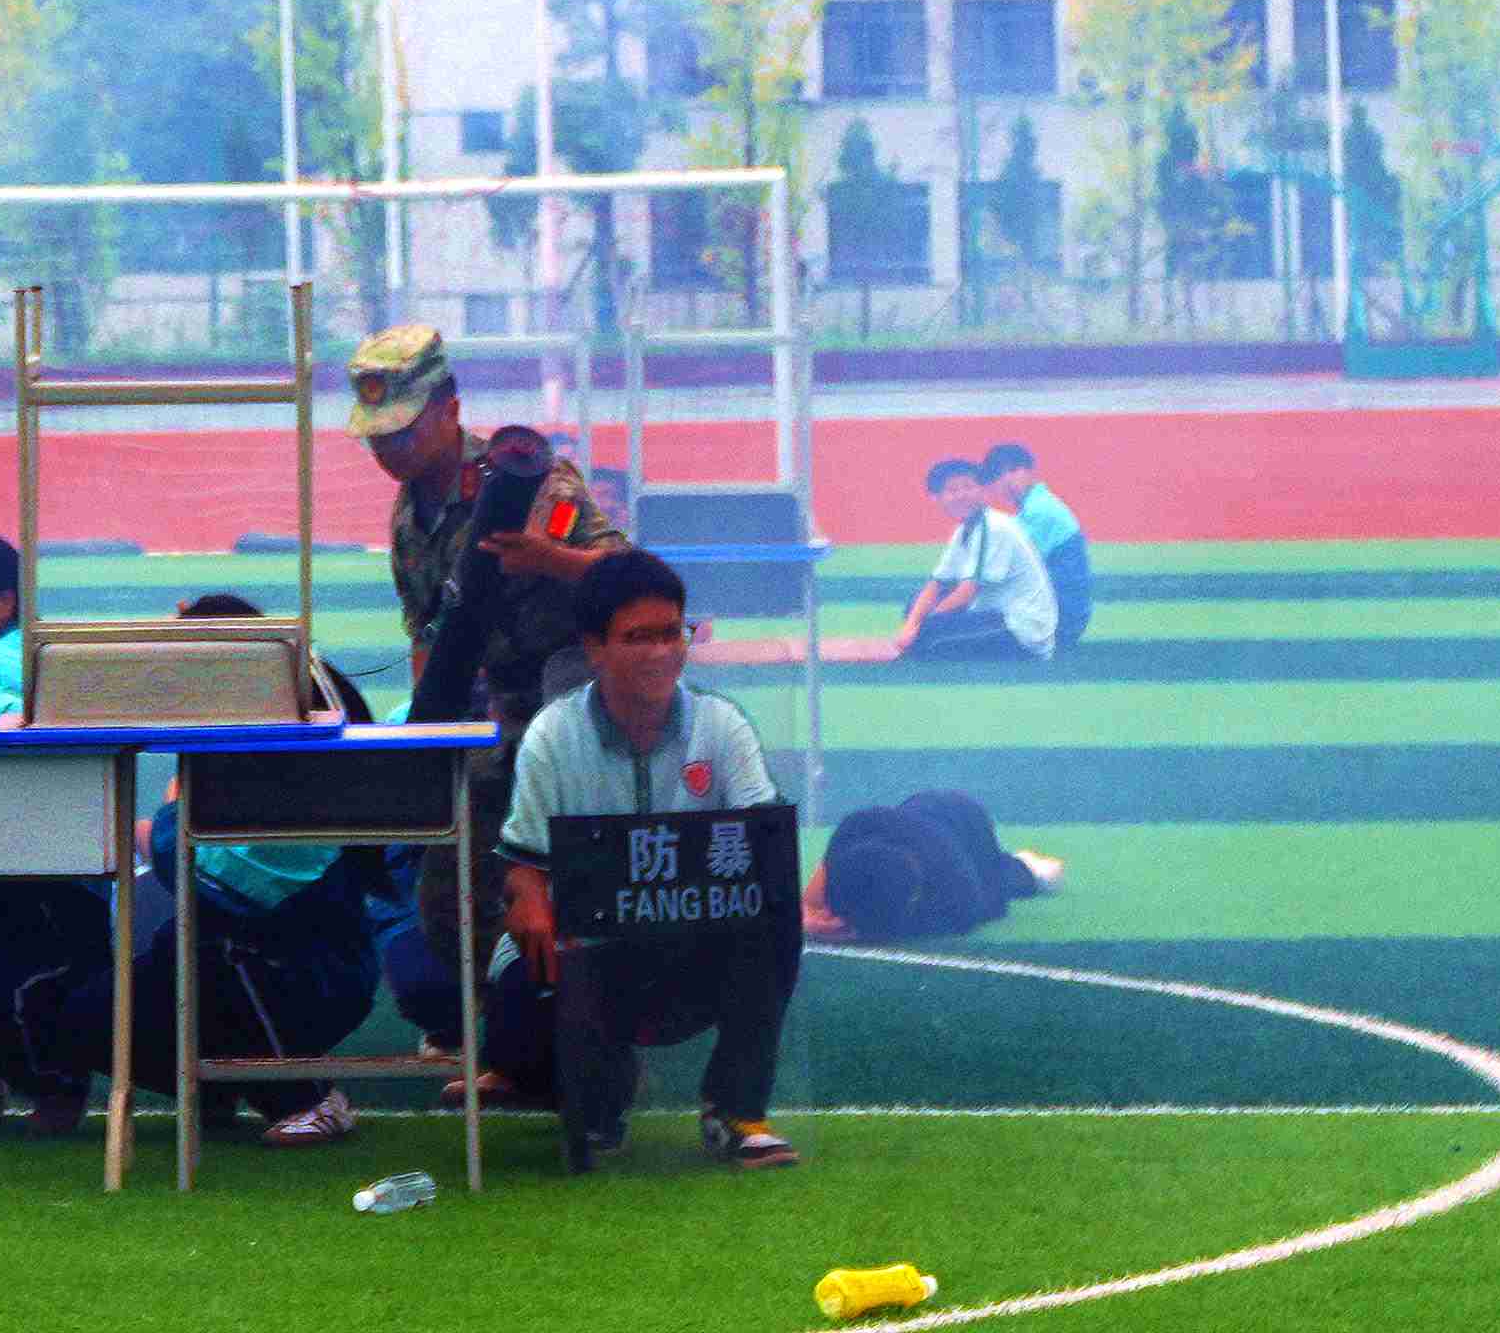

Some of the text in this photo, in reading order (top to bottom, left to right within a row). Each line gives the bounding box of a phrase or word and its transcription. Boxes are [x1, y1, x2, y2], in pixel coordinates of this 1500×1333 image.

[629, 821, 752, 883] 防暴
[616, 882, 763, 924] FANG BAO
